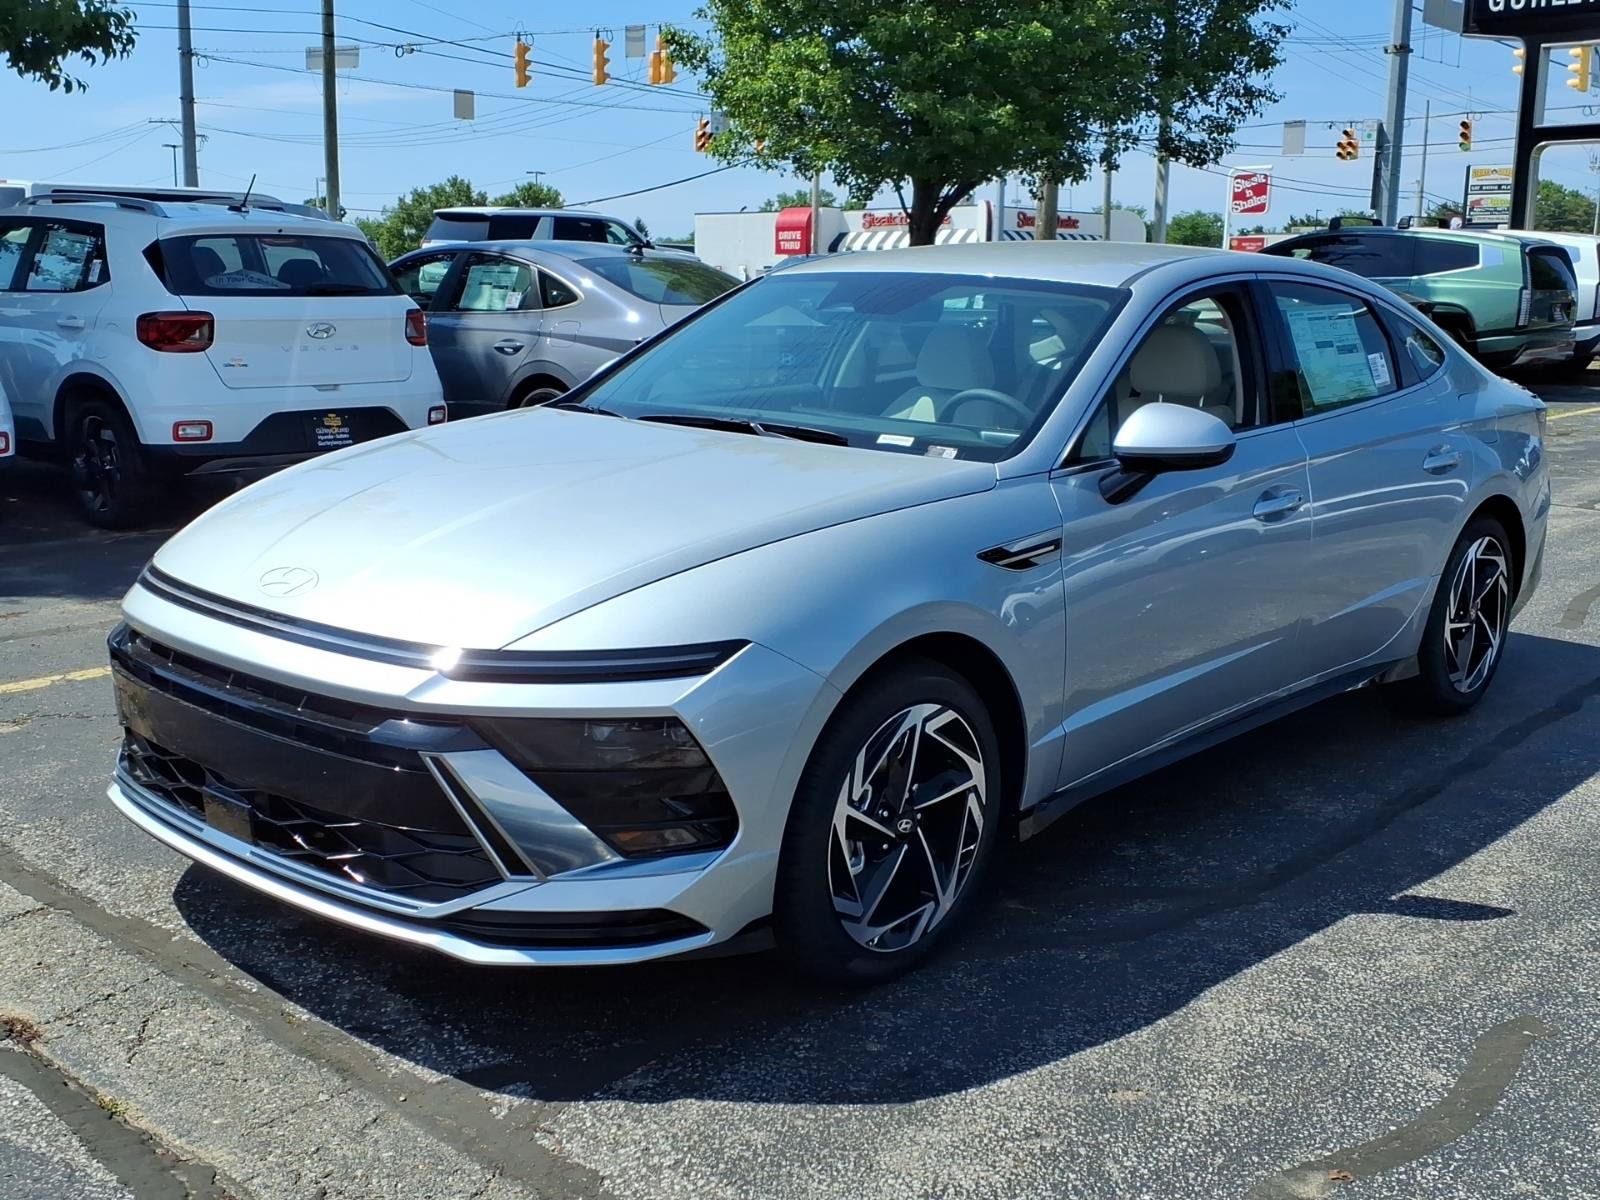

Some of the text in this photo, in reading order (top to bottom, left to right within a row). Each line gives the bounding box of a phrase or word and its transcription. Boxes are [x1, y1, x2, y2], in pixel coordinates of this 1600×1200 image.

[1488, 0, 1596, 12] GUR
[1234, 174, 1267, 192] Steak
[1232, 195, 1267, 213] Shake
[1056, 214, 1080, 229] hake
[778, 230, 802, 240] DRIVE
[780, 241, 801, 250] THRU
